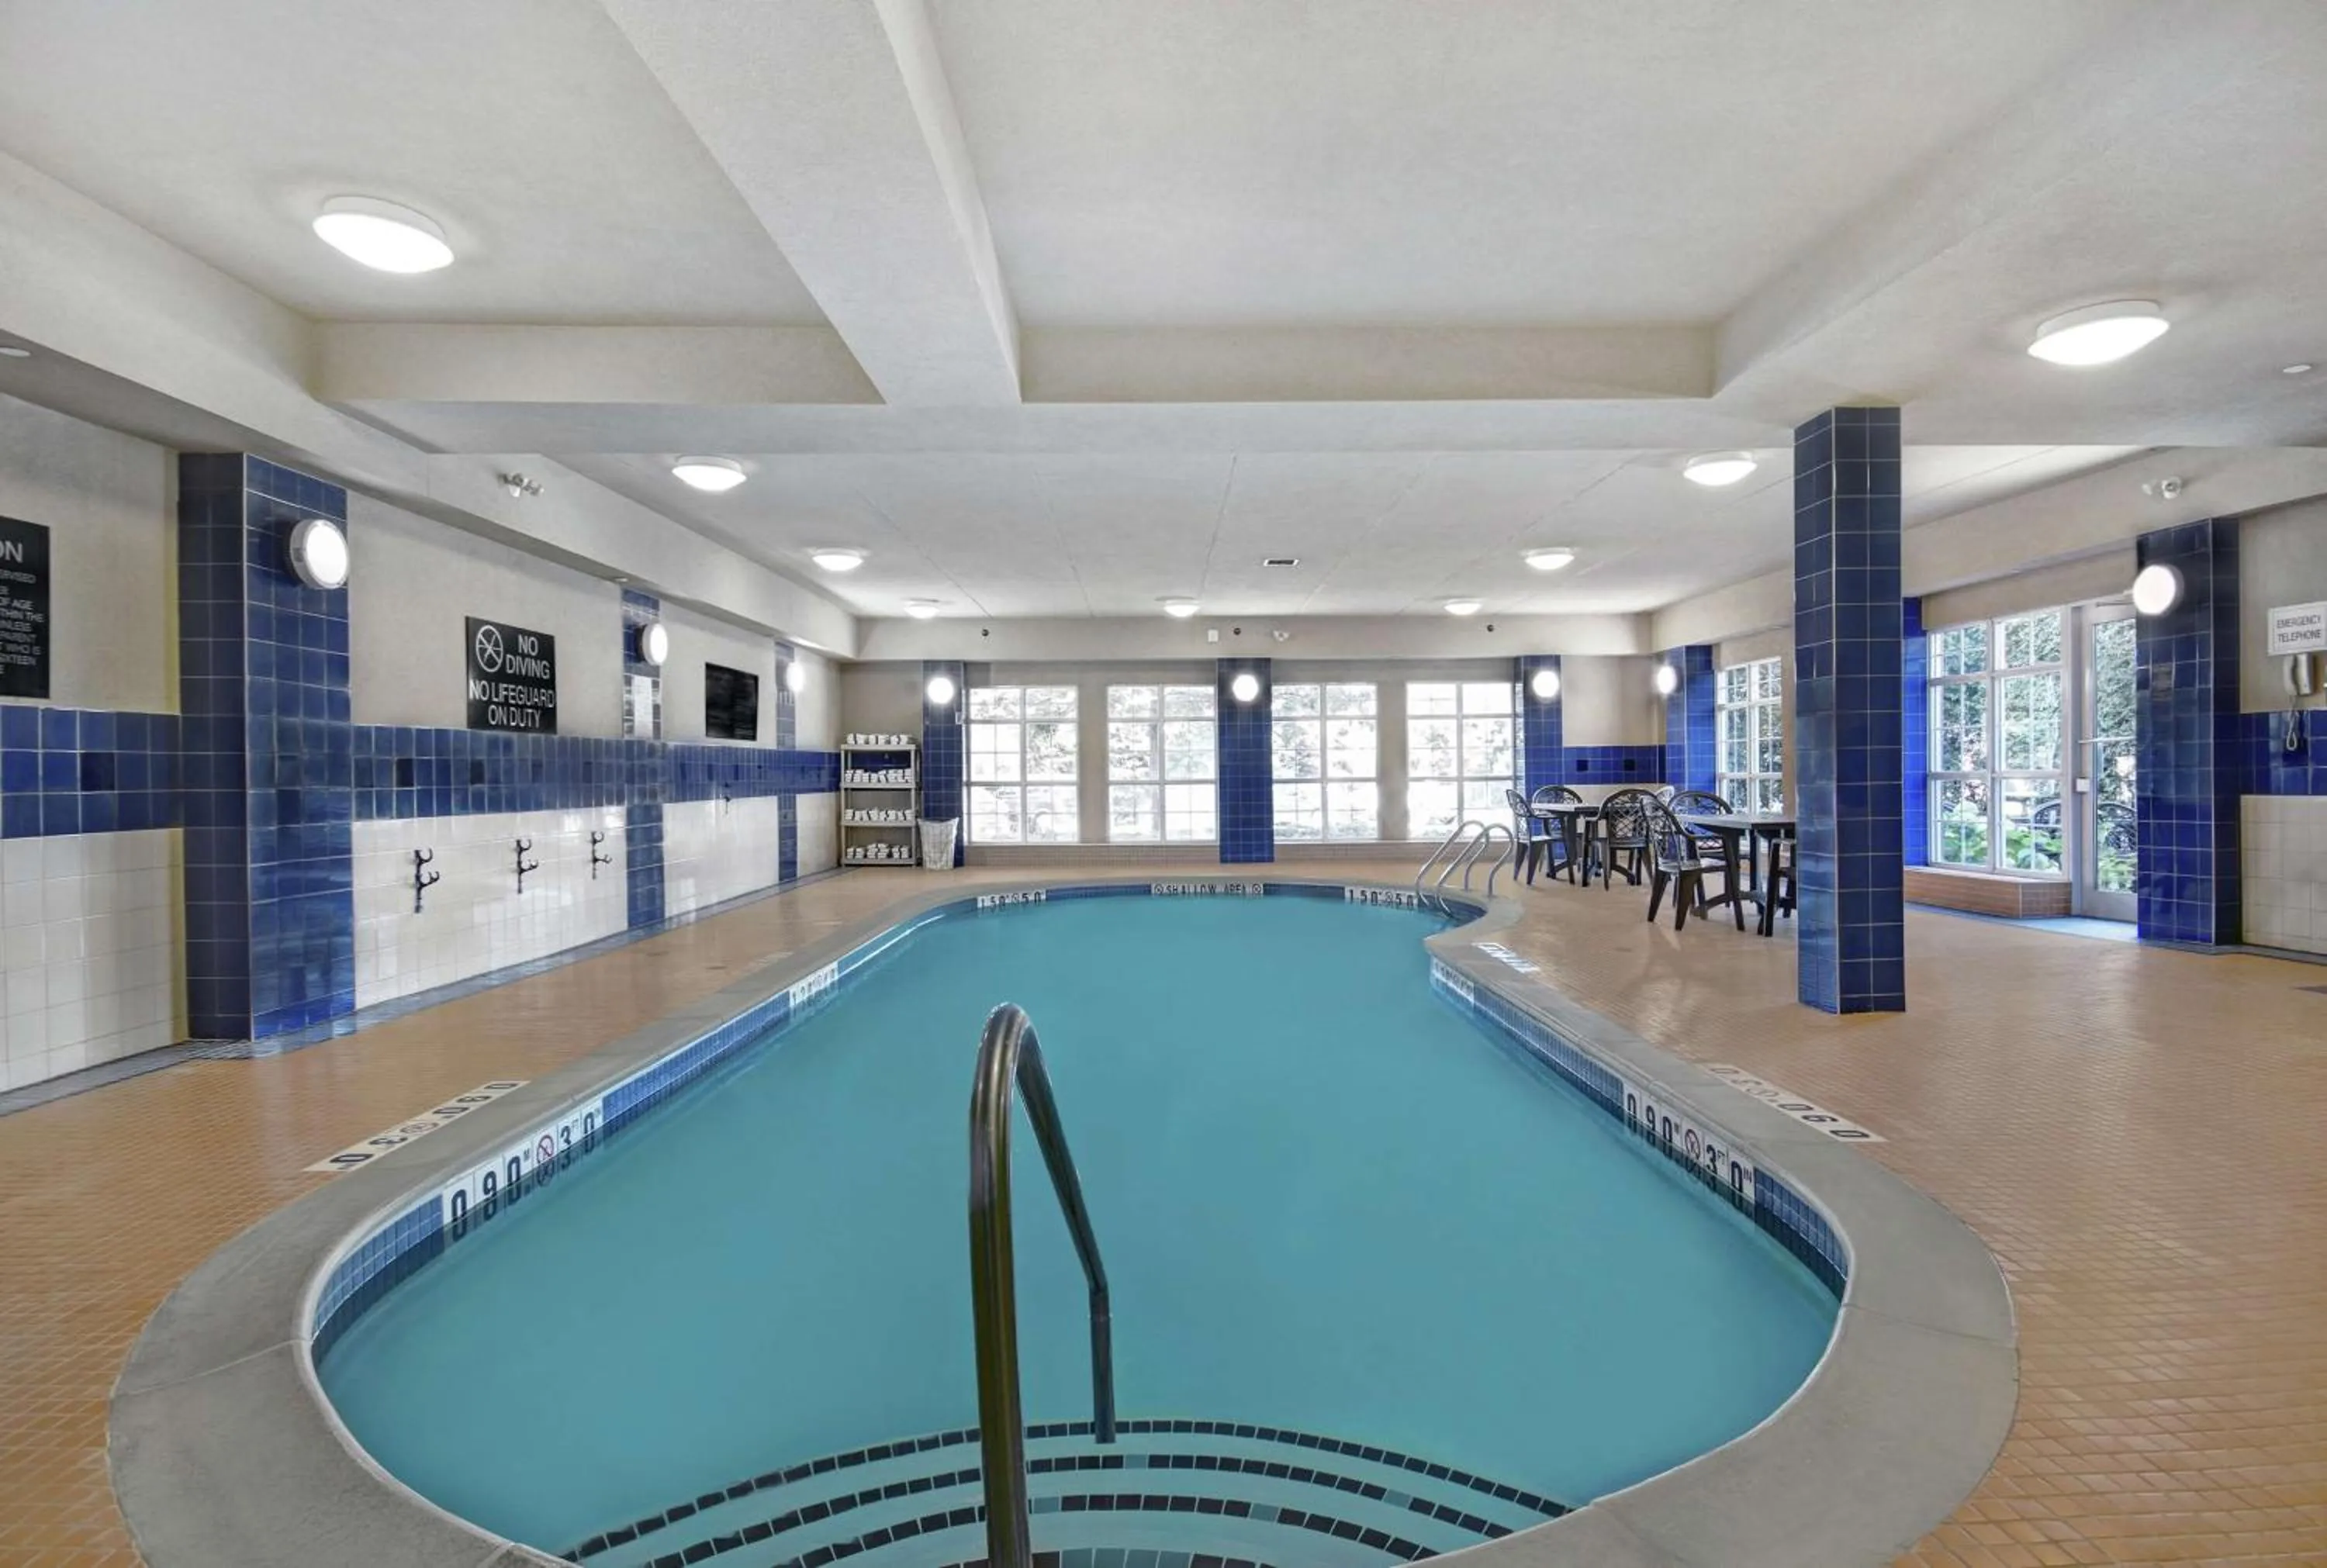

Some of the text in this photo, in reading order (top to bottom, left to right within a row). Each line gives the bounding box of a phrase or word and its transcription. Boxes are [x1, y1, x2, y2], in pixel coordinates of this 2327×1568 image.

[0, 540, 23, 563] N
[2277, 614, 2321, 628] EMERGENCY
[517, 634, 538, 656] NO
[2277, 629, 2321, 643] TELEPHONE
[506, 654, 550, 679] DIVING
[469, 679, 555, 708] NO LIFEGUARD
[488, 705, 541, 729] ON DUTY
